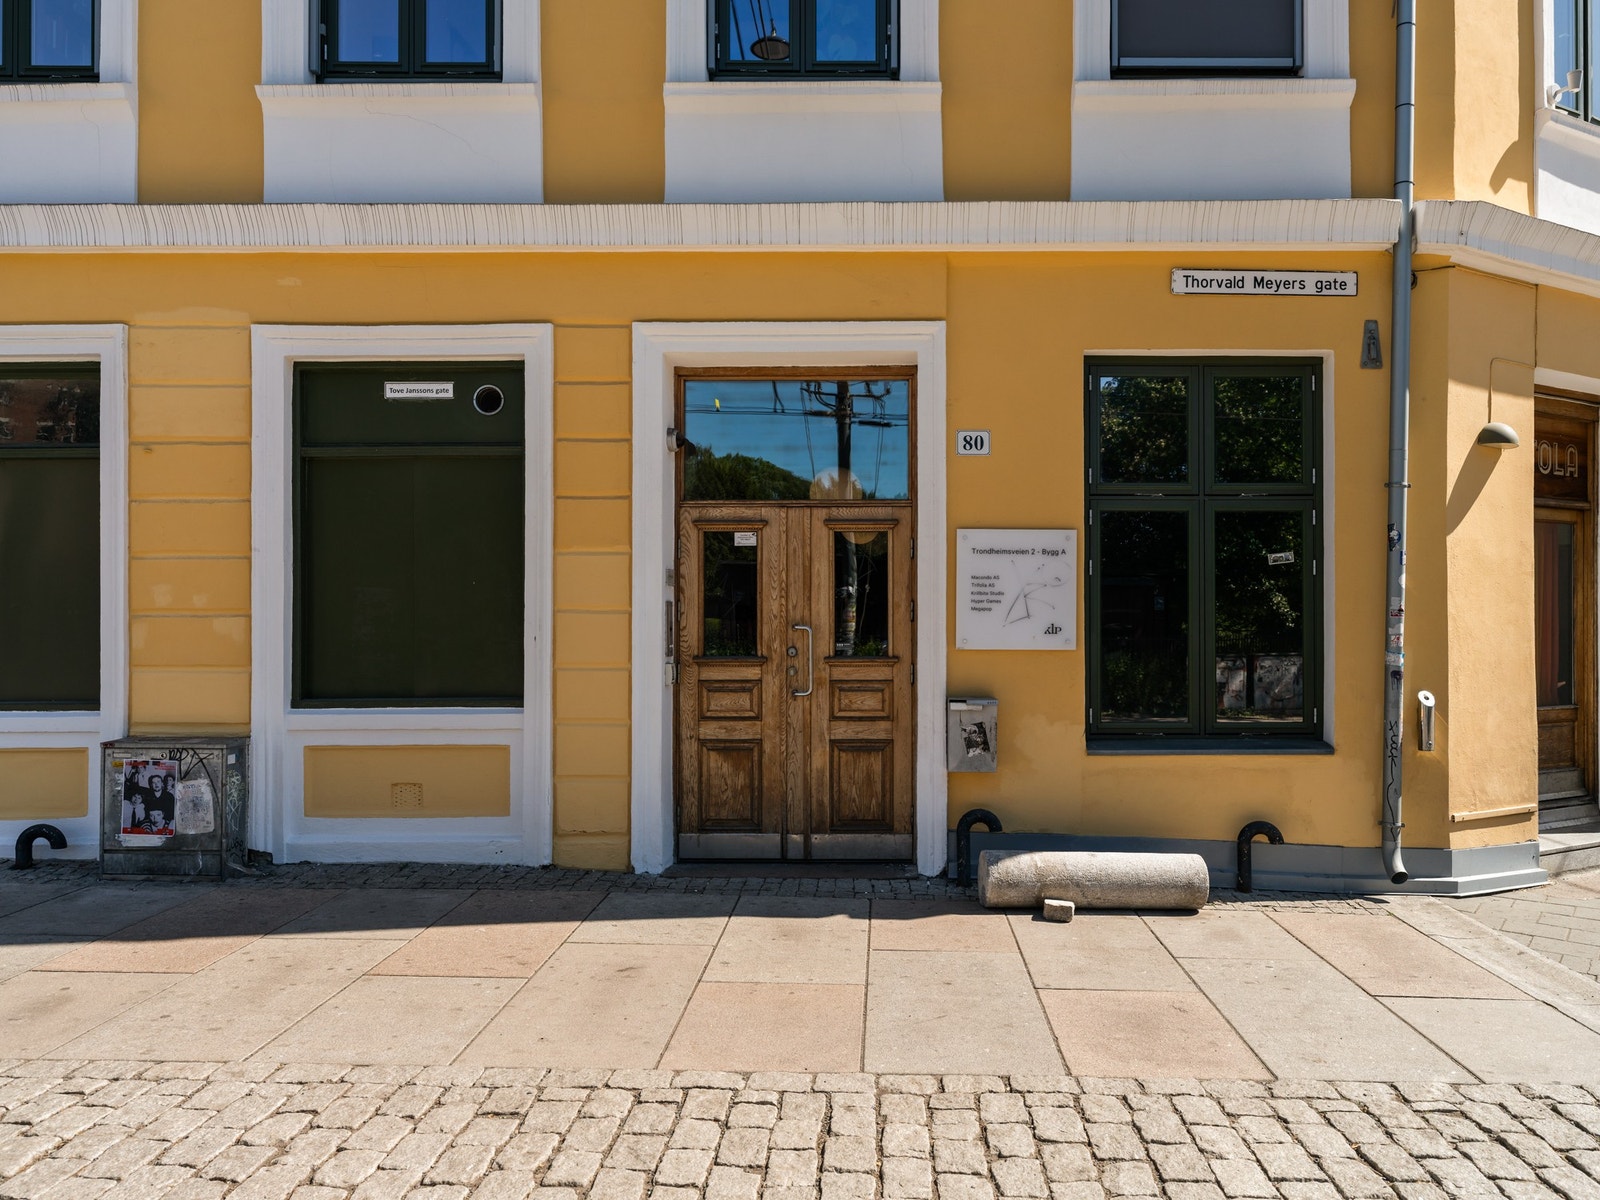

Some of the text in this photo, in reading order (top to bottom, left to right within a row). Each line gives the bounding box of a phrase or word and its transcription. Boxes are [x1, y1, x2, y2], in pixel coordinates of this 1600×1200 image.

[1183, 275, 1347, 293] Thorvald Meyers gate
[435, 387, 450, 395] gate
[963, 434, 984, 451] 80
[971, 547, 1030, 555] Trondheimsveien
[1041, 548, 1059, 557] Bygg
